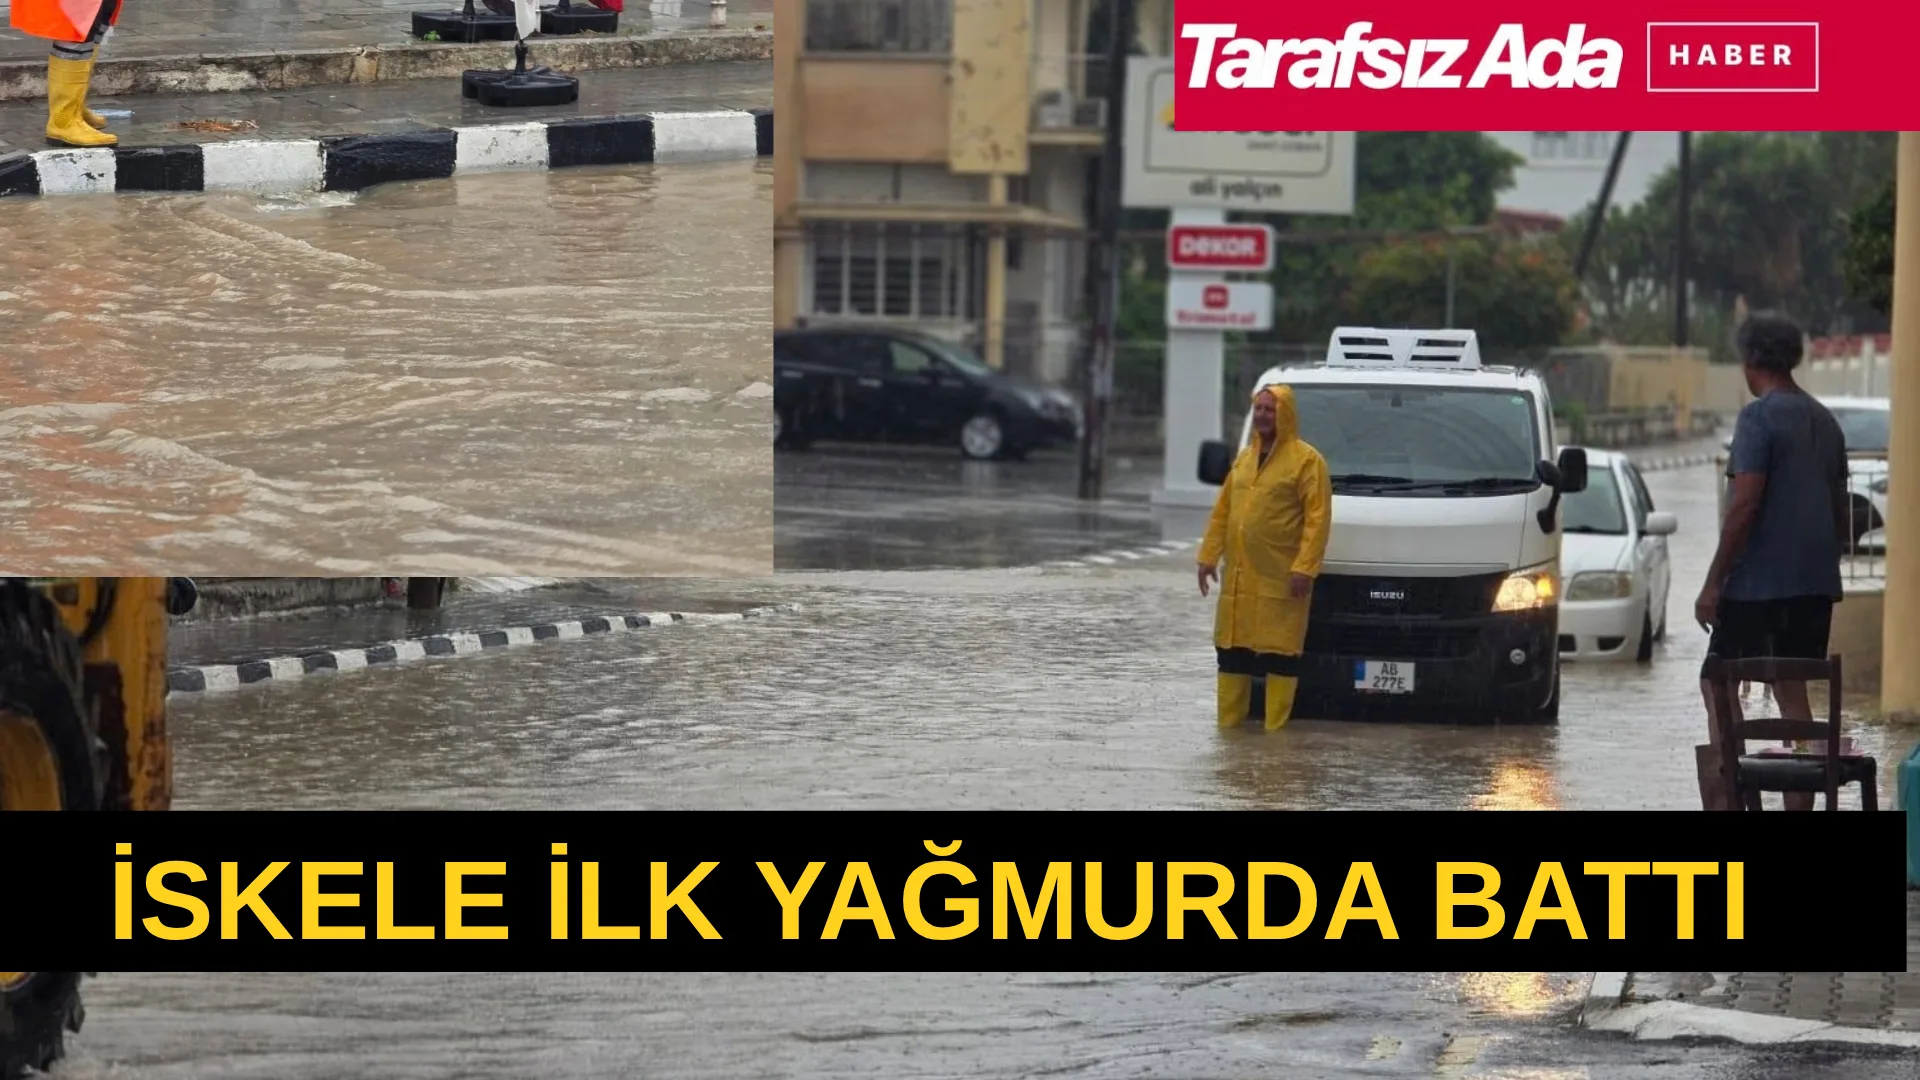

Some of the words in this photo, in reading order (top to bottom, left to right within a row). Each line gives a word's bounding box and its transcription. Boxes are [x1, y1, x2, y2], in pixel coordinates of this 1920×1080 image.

[1370, 591, 1405, 599] ISUZU
[1380, 662, 1399, 676] AB
[1372, 676, 1405, 690] 277E
